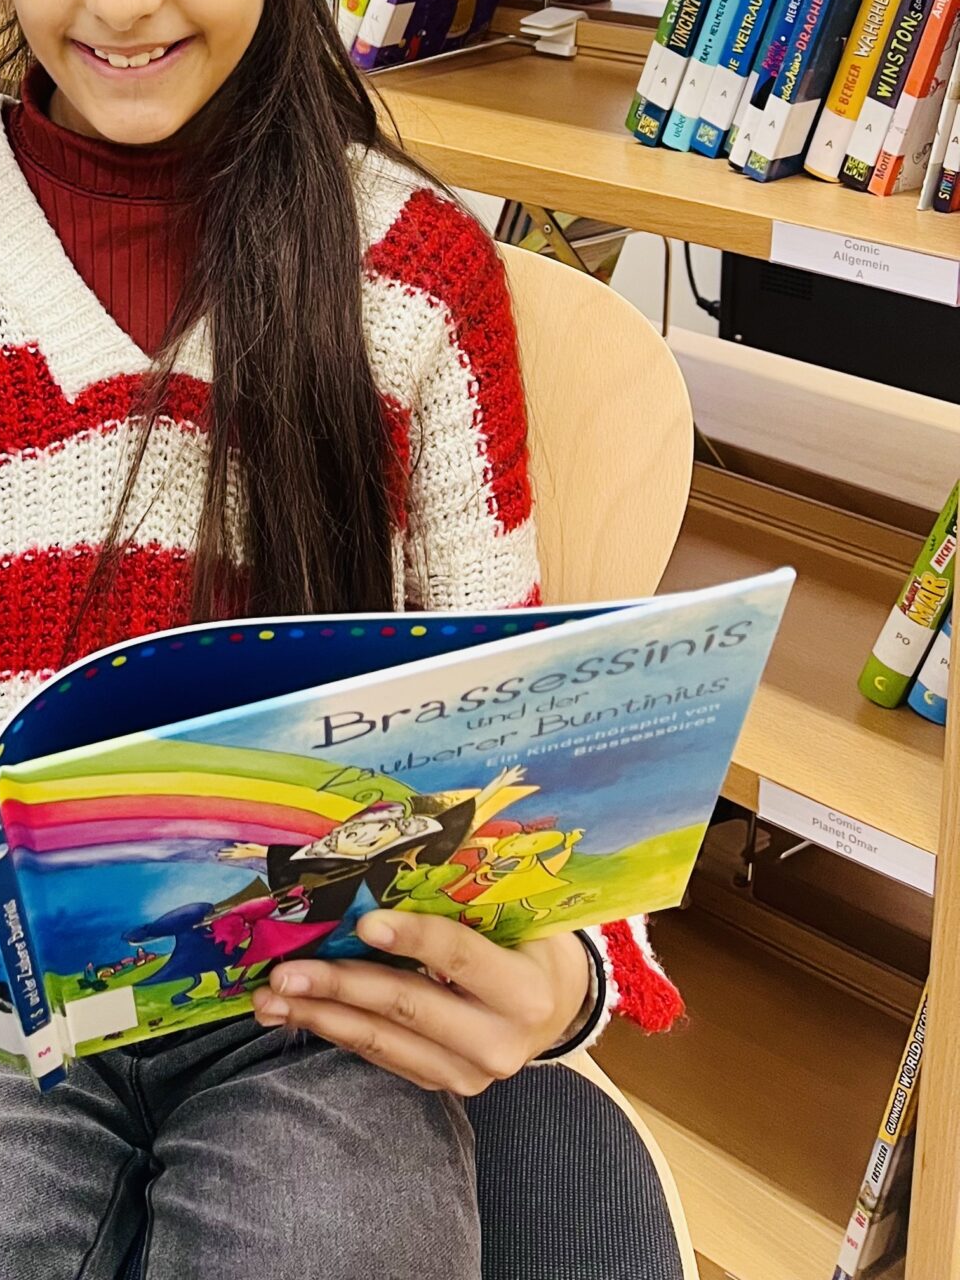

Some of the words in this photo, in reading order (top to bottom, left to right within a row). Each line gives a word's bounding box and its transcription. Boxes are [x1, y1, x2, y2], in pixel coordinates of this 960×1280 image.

[841, 64, 863, 104] BERGER
[833, 251, 890, 272] Allgemein
[844, 239, 880, 256] Comic
[855, 270, 864, 279] A
[933, 538, 956, 567] NICHT
[896, 632, 911, 646] PO
[312, 619, 754, 750] Brassessinis
[467, 703, 528, 731] und
[536, 690, 589, 714] der
[318, 730, 518, 792] Zauberer
[530, 677, 730, 737] Buntinius
[486, 752, 519, 768] Ein
[527, 713, 678, 757] Kinderhörspiel
[684, 702, 722, 718] von
[574, 714, 717, 758] Brassessoires
[812, 817, 845, 840] Planet
[848, 833, 878, 854] Omar
[828, 812, 862, 834] Comic
[836, 841, 853, 854] PO
[885, 1088, 907, 1135] GUINNESS
[899, 1041, 922, 1088] WORLD
[871, 1145, 889, 1183] ERSTLESER
